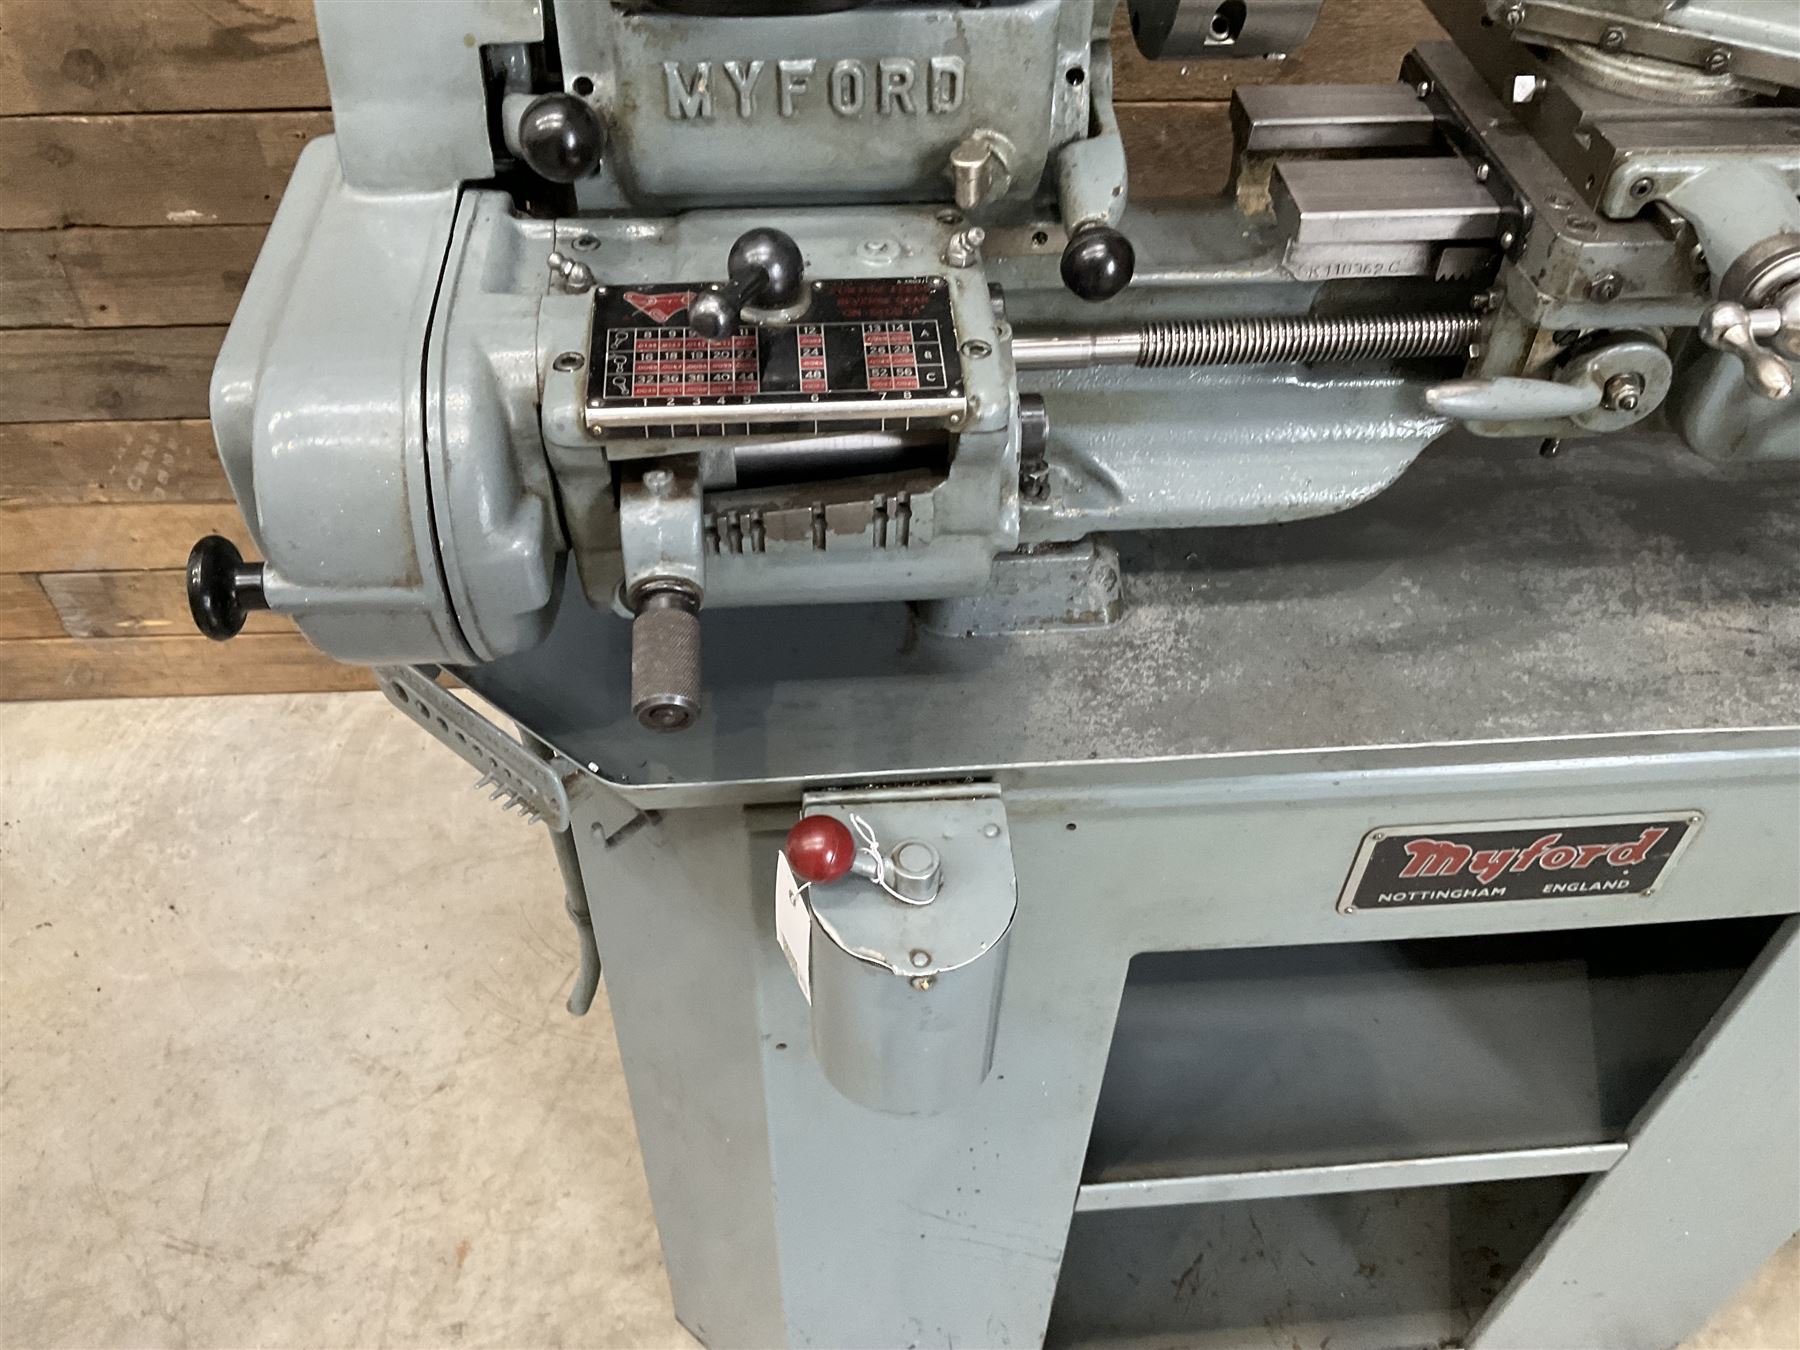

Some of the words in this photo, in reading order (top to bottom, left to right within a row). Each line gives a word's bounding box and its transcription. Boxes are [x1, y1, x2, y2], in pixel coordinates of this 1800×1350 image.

[661, 55, 966, 120] MYFORD
[740, 328, 749, 336] 11
[803, 326, 816, 334] 12
[868, 324, 881, 332] 13
[891, 323, 904, 332] 14
[920, 328, 930, 338] A
[640, 352, 653, 361] 16
[665, 351, 678, 361] 18
[690, 351, 704, 360] 19
[713, 350, 730, 359] 20
[802, 347, 819, 356] 24
[870, 346, 886, 355] 26
[894, 345, 910, 353] 28
[923, 350, 933, 360] B
[638, 375, 655, 384] 32
[662, 374, 679, 383] 36
[688, 373, 705, 382] 38
[713, 373, 730, 381] 40
[804, 370, 822, 379] 48
[871, 368, 888, 377] 52
[896, 368, 913, 376] 56
[926, 371, 937, 382] C
[666, 397, 675, 407] 2
[692, 396, 701, 406] 3
[716, 395, 726, 405] 4
[810, 393, 820, 403] 6
[879, 391, 888, 401] 7
[903, 390, 913, 400] 8
[1399, 827, 1669, 885] Myford
[1378, 886, 1507, 903] NOTTINGHAM
[1542, 879, 1630, 895] ENGLAND
